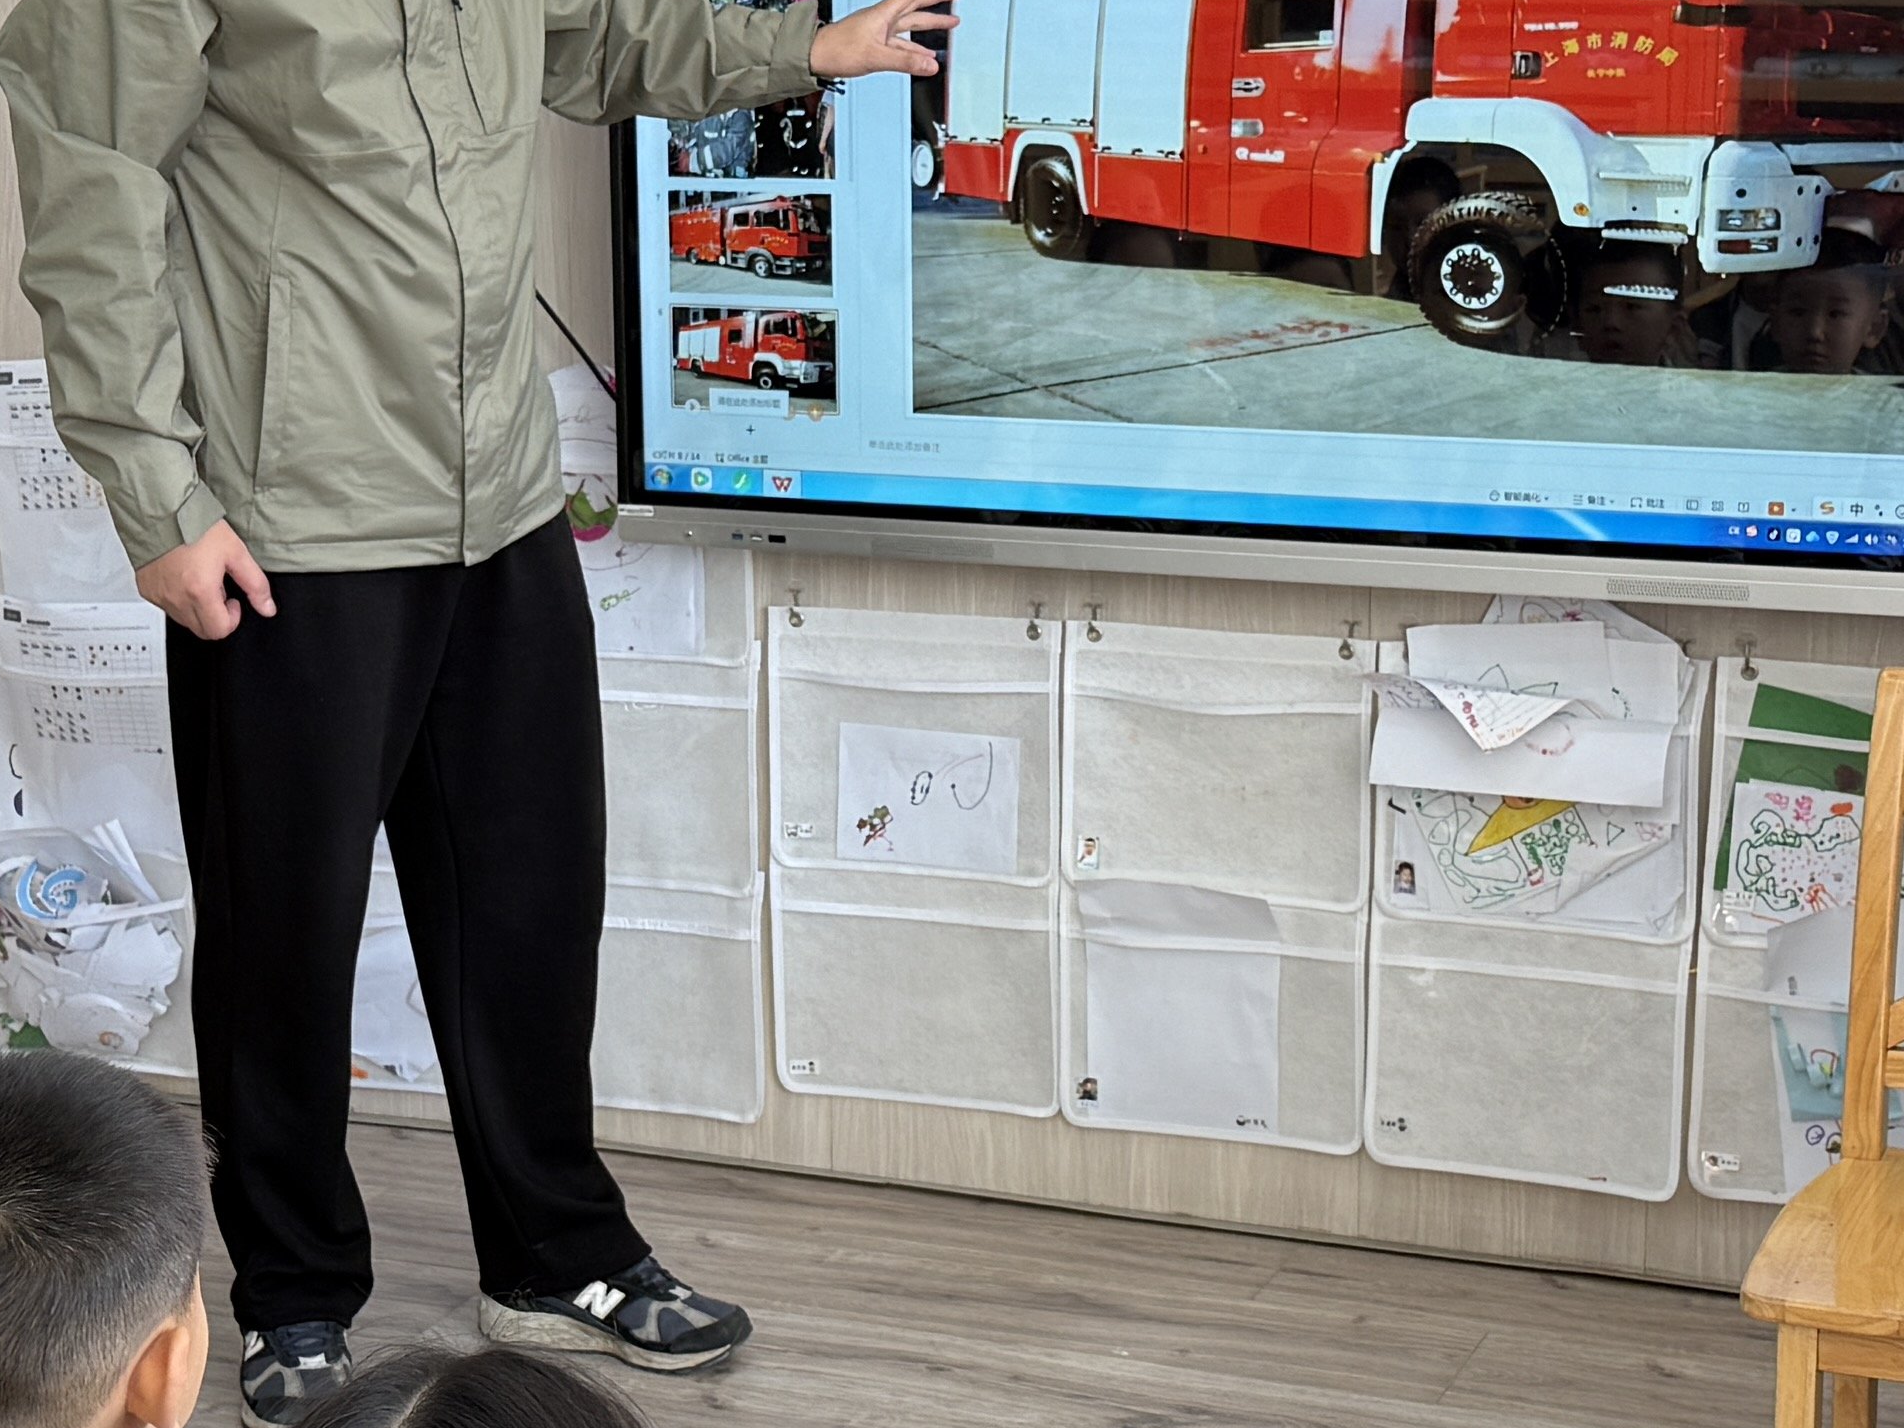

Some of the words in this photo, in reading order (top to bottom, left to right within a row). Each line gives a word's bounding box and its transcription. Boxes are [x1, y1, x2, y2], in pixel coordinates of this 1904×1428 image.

[1544, 31, 1680, 68] 上海市消防局
[1849, 502, 1864, 516] 中
[572, 1279, 626, 1320] N
